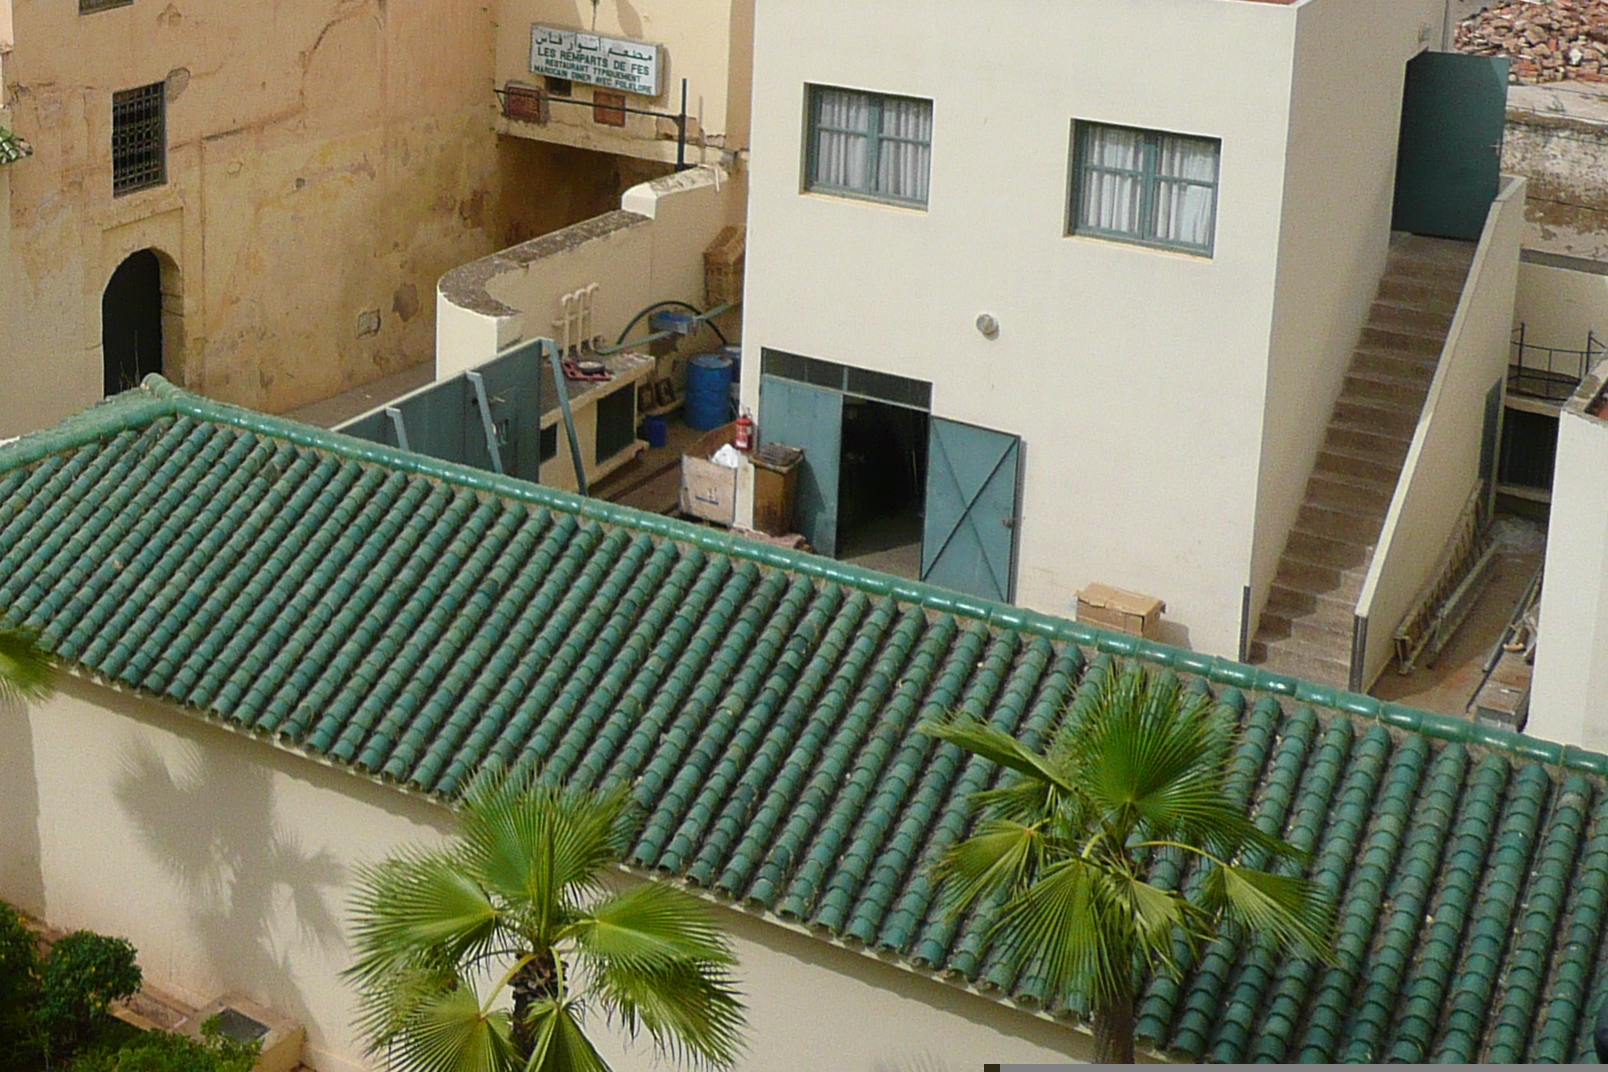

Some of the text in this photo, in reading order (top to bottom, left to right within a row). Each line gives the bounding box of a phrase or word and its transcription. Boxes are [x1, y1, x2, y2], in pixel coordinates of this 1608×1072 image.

[537, 47, 650, 76] LES REMPARTS DE FES
[545, 58, 641, 82] RESTAURANT TYPIQUEMENT
[534, 65, 653, 94] MAROCAIN DINER AVEC FOLKLORE
